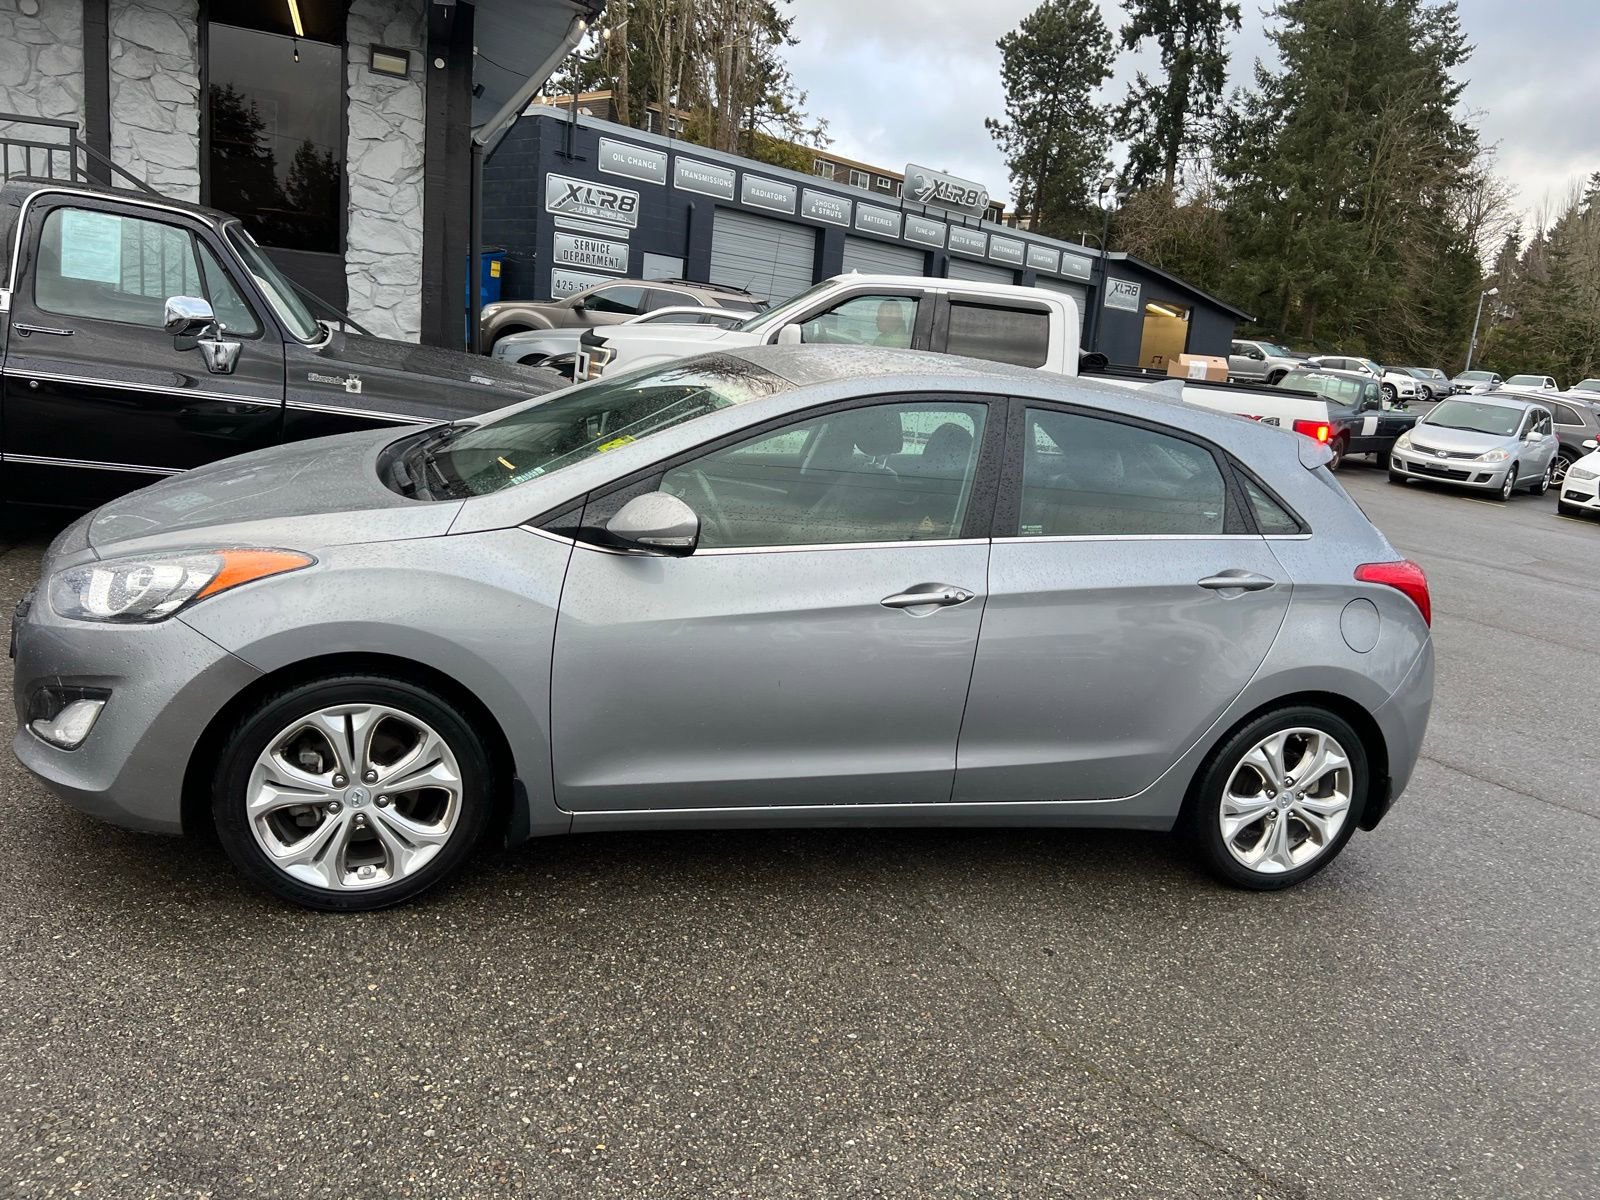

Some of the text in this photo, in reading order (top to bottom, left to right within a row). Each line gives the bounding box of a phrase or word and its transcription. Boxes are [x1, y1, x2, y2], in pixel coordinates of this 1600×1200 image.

[613, 153, 657, 170] OIL CHANGE
[680, 169, 733, 188] TRANSMISSIONS
[551, 182, 637, 213] XLR8
[751, 188, 787, 202] RADIATORS
[919, 179, 979, 207] XLR8
[815, 199, 840, 211] SHOCKS
[819, 207, 842, 219] STRUTS
[863, 214, 892, 227] BATTERIES
[915, 226, 936, 237] TUNE-UP
[574, 239, 611, 254] SERVICE
[563, 249, 619, 268] DEPARTMENT
[1109, 281, 1139, 296] XLR8
